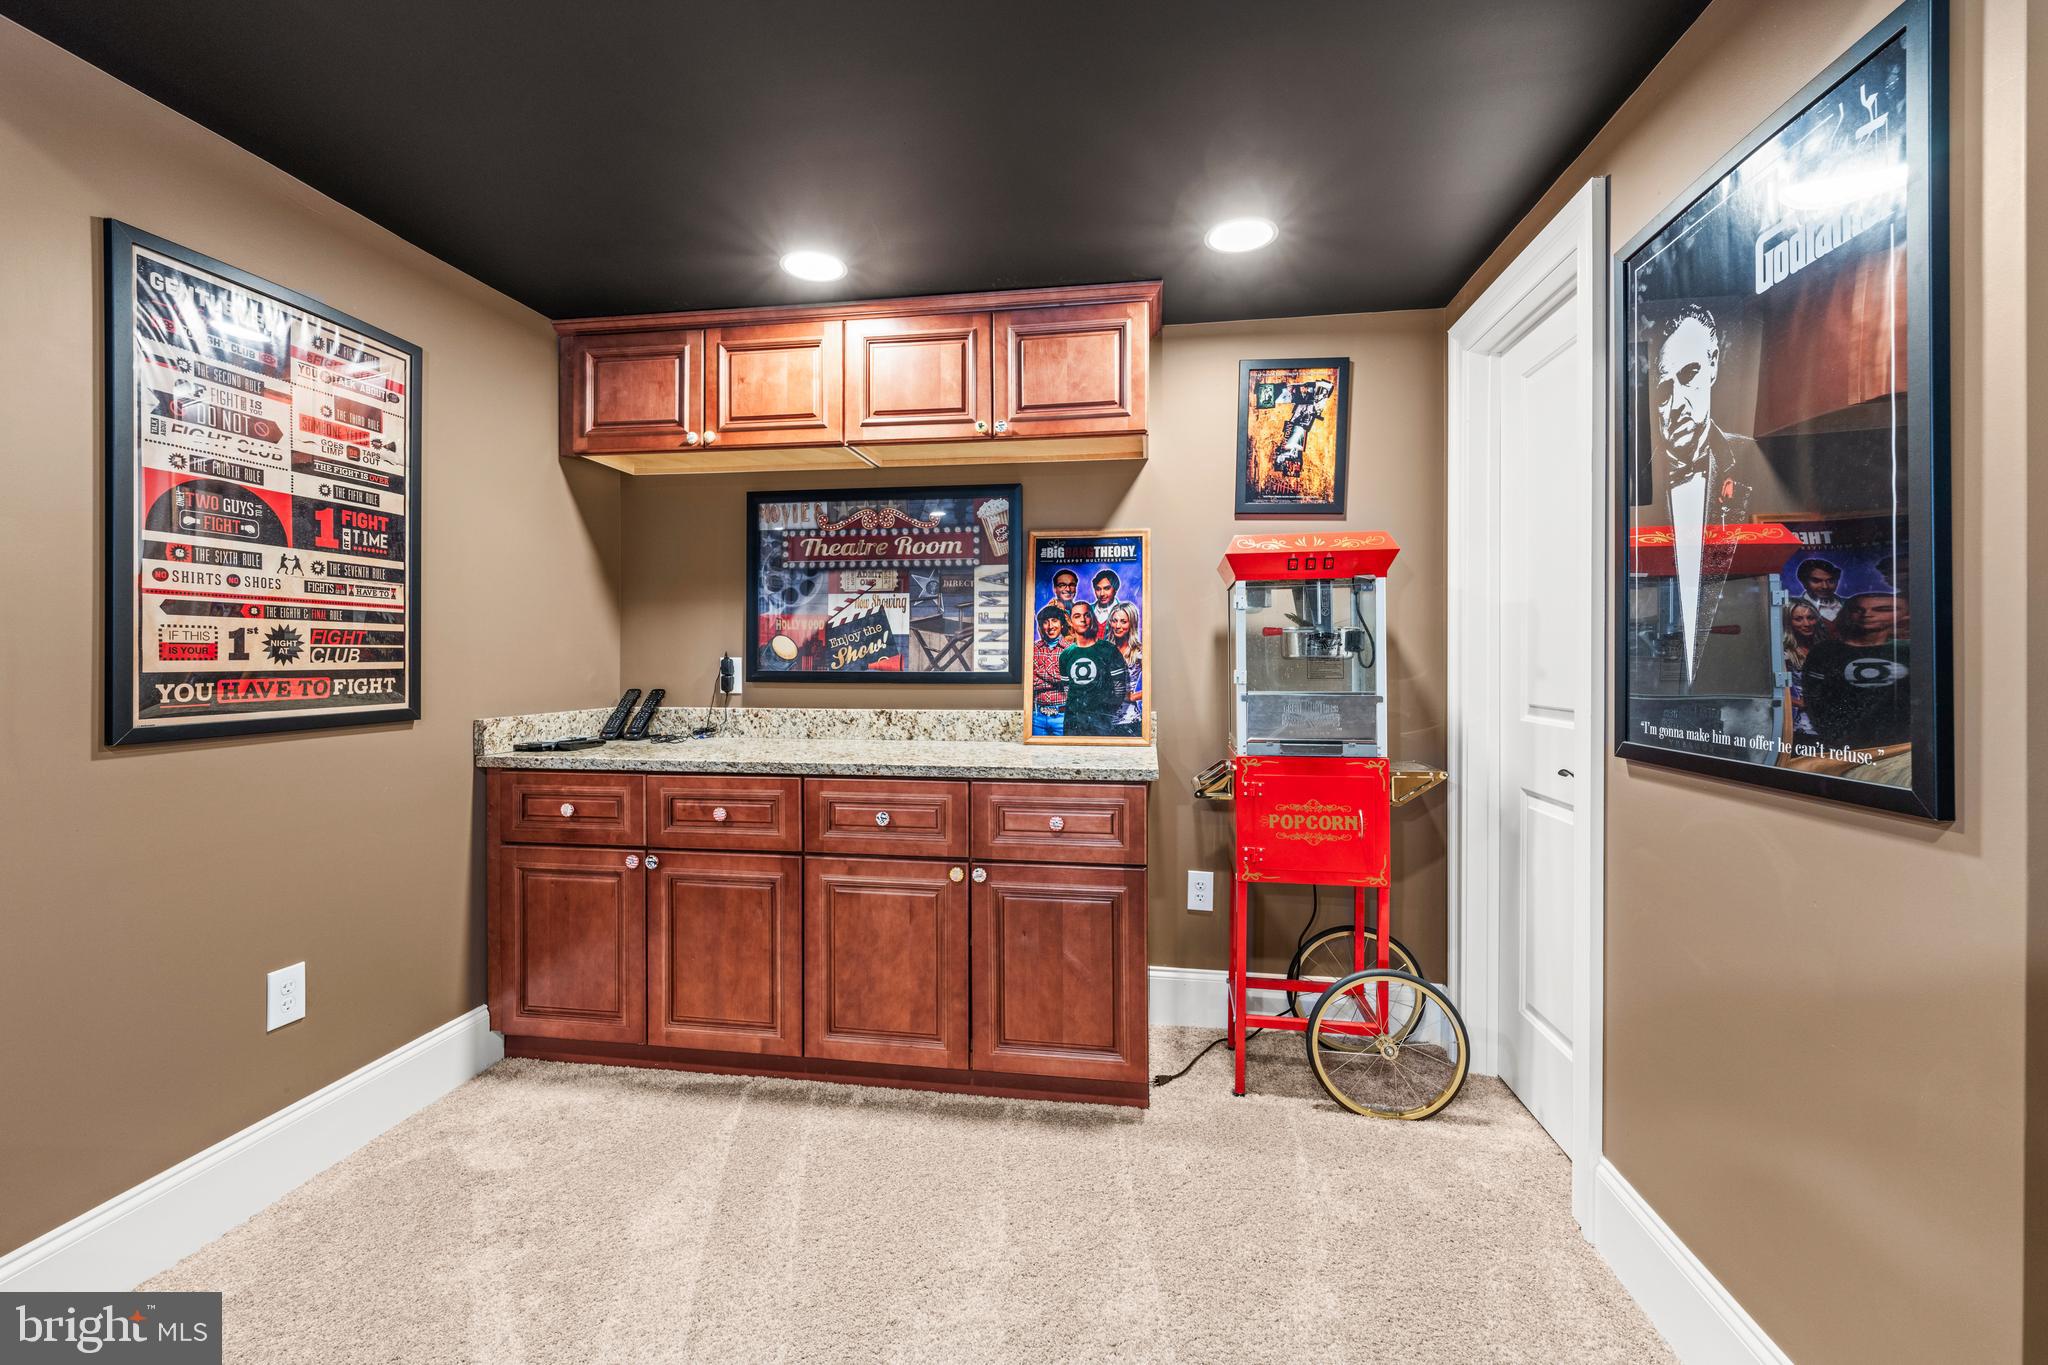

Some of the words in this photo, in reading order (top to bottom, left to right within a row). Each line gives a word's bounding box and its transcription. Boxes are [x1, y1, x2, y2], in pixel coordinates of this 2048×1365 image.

[196, 362, 209, 379] THE
[213, 369, 241, 388] SECOND
[244, 377, 262, 393] RULE
[211, 387, 239, 407] FIGHT
[249, 399, 262, 410] IS
[360, 383, 385, 400] ABOUT
[249, 408, 263, 416] YOU
[223, 410, 251, 436] NOT
[321, 439, 344, 450] GOES
[321, 446, 344, 457] LIMP
[362, 449, 381, 460] TAPS
[193, 457, 208, 473] THE
[212, 460, 240, 479] FOURTH
[244, 466, 261, 482] RULE
[362, 457, 380, 466] OUT
[314, 462, 333, 472] THE
[333, 465, 360, 478] FIGHT
[369, 474, 389, 485] OVER
[185, 491, 219, 511] TWO
[223, 498, 255, 517] GUYS
[335, 486, 345, 498] THE
[347, 489, 363, 503] FIFTH
[365, 492, 378, 506] RULE
[203, 515, 241, 534] FIGHT
[315, 507, 340, 549] 1
[341, 509, 389, 532] FIGHT
[352, 529, 389, 549] TIME
[800, 538, 888, 557] Theatre
[894, 536, 963, 556] Room
[195, 547, 210, 562] THE
[214, 550, 238, 565] SIXTH
[242, 552, 260, 568] RULE
[154, 570, 168, 579] NO
[172, 570, 222, 586] SHIRTS
[244, 575, 282, 590] SHOES
[329, 562, 341, 575] THE
[344, 564, 369, 578] SEVENTH
[372, 568, 386, 580] RULE
[307, 581, 335, 593] FIGHTS
[356, 587, 378, 597] HAVE
[871, 593, 907, 614] Showing
[266, 606, 277, 618] THE
[280, 606, 300, 619] EIGHTH
[303, 608, 309, 620] &
[311, 609, 327, 620] FINAL
[329, 609, 343, 621] RULE
[168, 630, 179, 641] IF
[182, 630, 211, 642] THIS
[270, 638, 299, 647] NIGHT
[311, 629, 367, 646] FIGHT
[829, 629, 861, 649] Enjoy
[863, 624, 883, 637] the
[168, 647, 178, 655] IS
[180, 646, 209, 656] YOUR
[278, 647, 290, 655] AT
[311, 647, 361, 663] CLUB
[830, 630, 890, 670] Show!
[155, 682, 215, 703] YOU
[221, 680, 292, 701] HAVE
[297, 679, 328, 697] TO
[333, 677, 396, 696] FIGHT
[1658, 726, 1684, 739] gonna
[1686, 729, 1710, 743] make
[1712, 729, 1731, 745] him
[1734, 736, 1746, 747] an
[1749, 734, 1774, 752] offer
[1778, 736, 1791, 753] he
[1269, 814, 1359, 831] POPCORN
